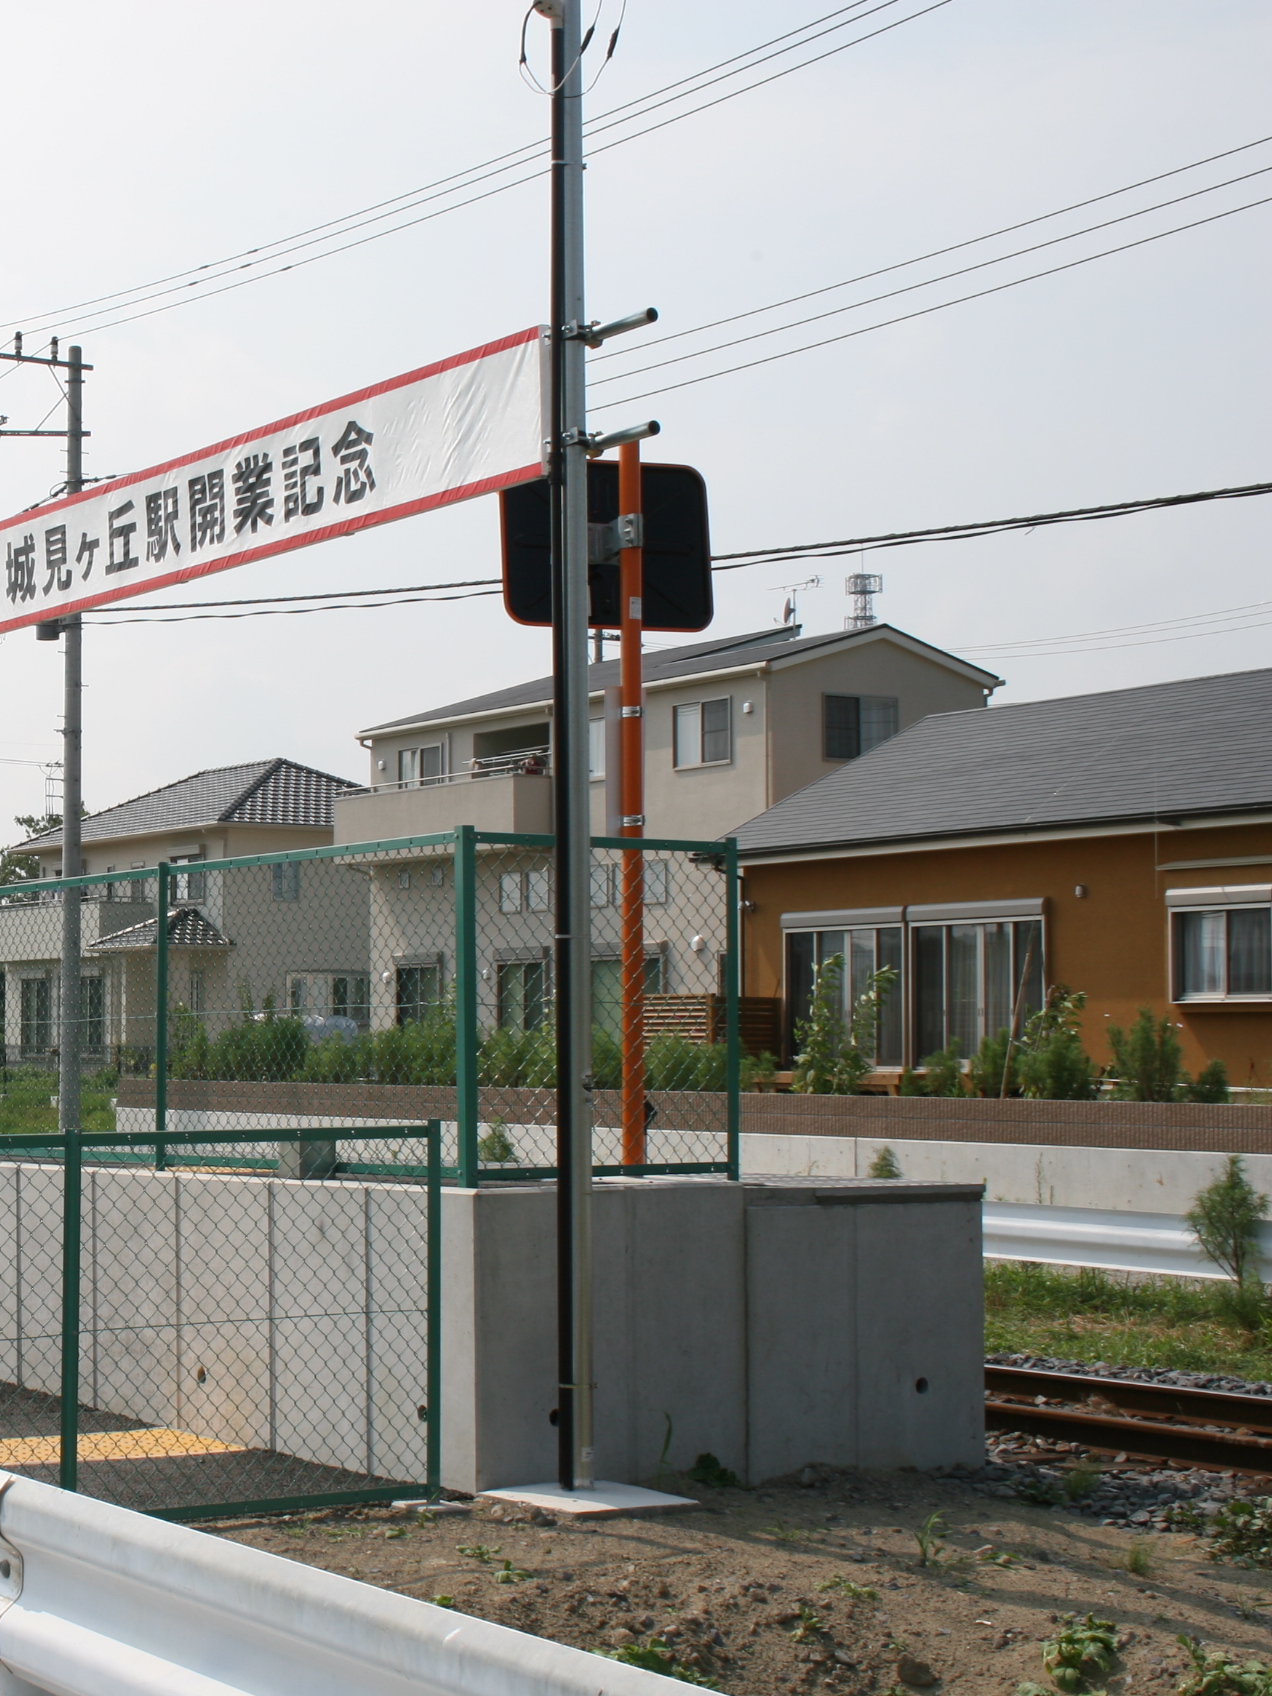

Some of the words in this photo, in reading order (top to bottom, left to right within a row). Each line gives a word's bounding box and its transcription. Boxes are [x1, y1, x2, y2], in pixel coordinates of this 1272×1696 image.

[6, 420, 376, 604] 城見ヶ丘駅開業記念
